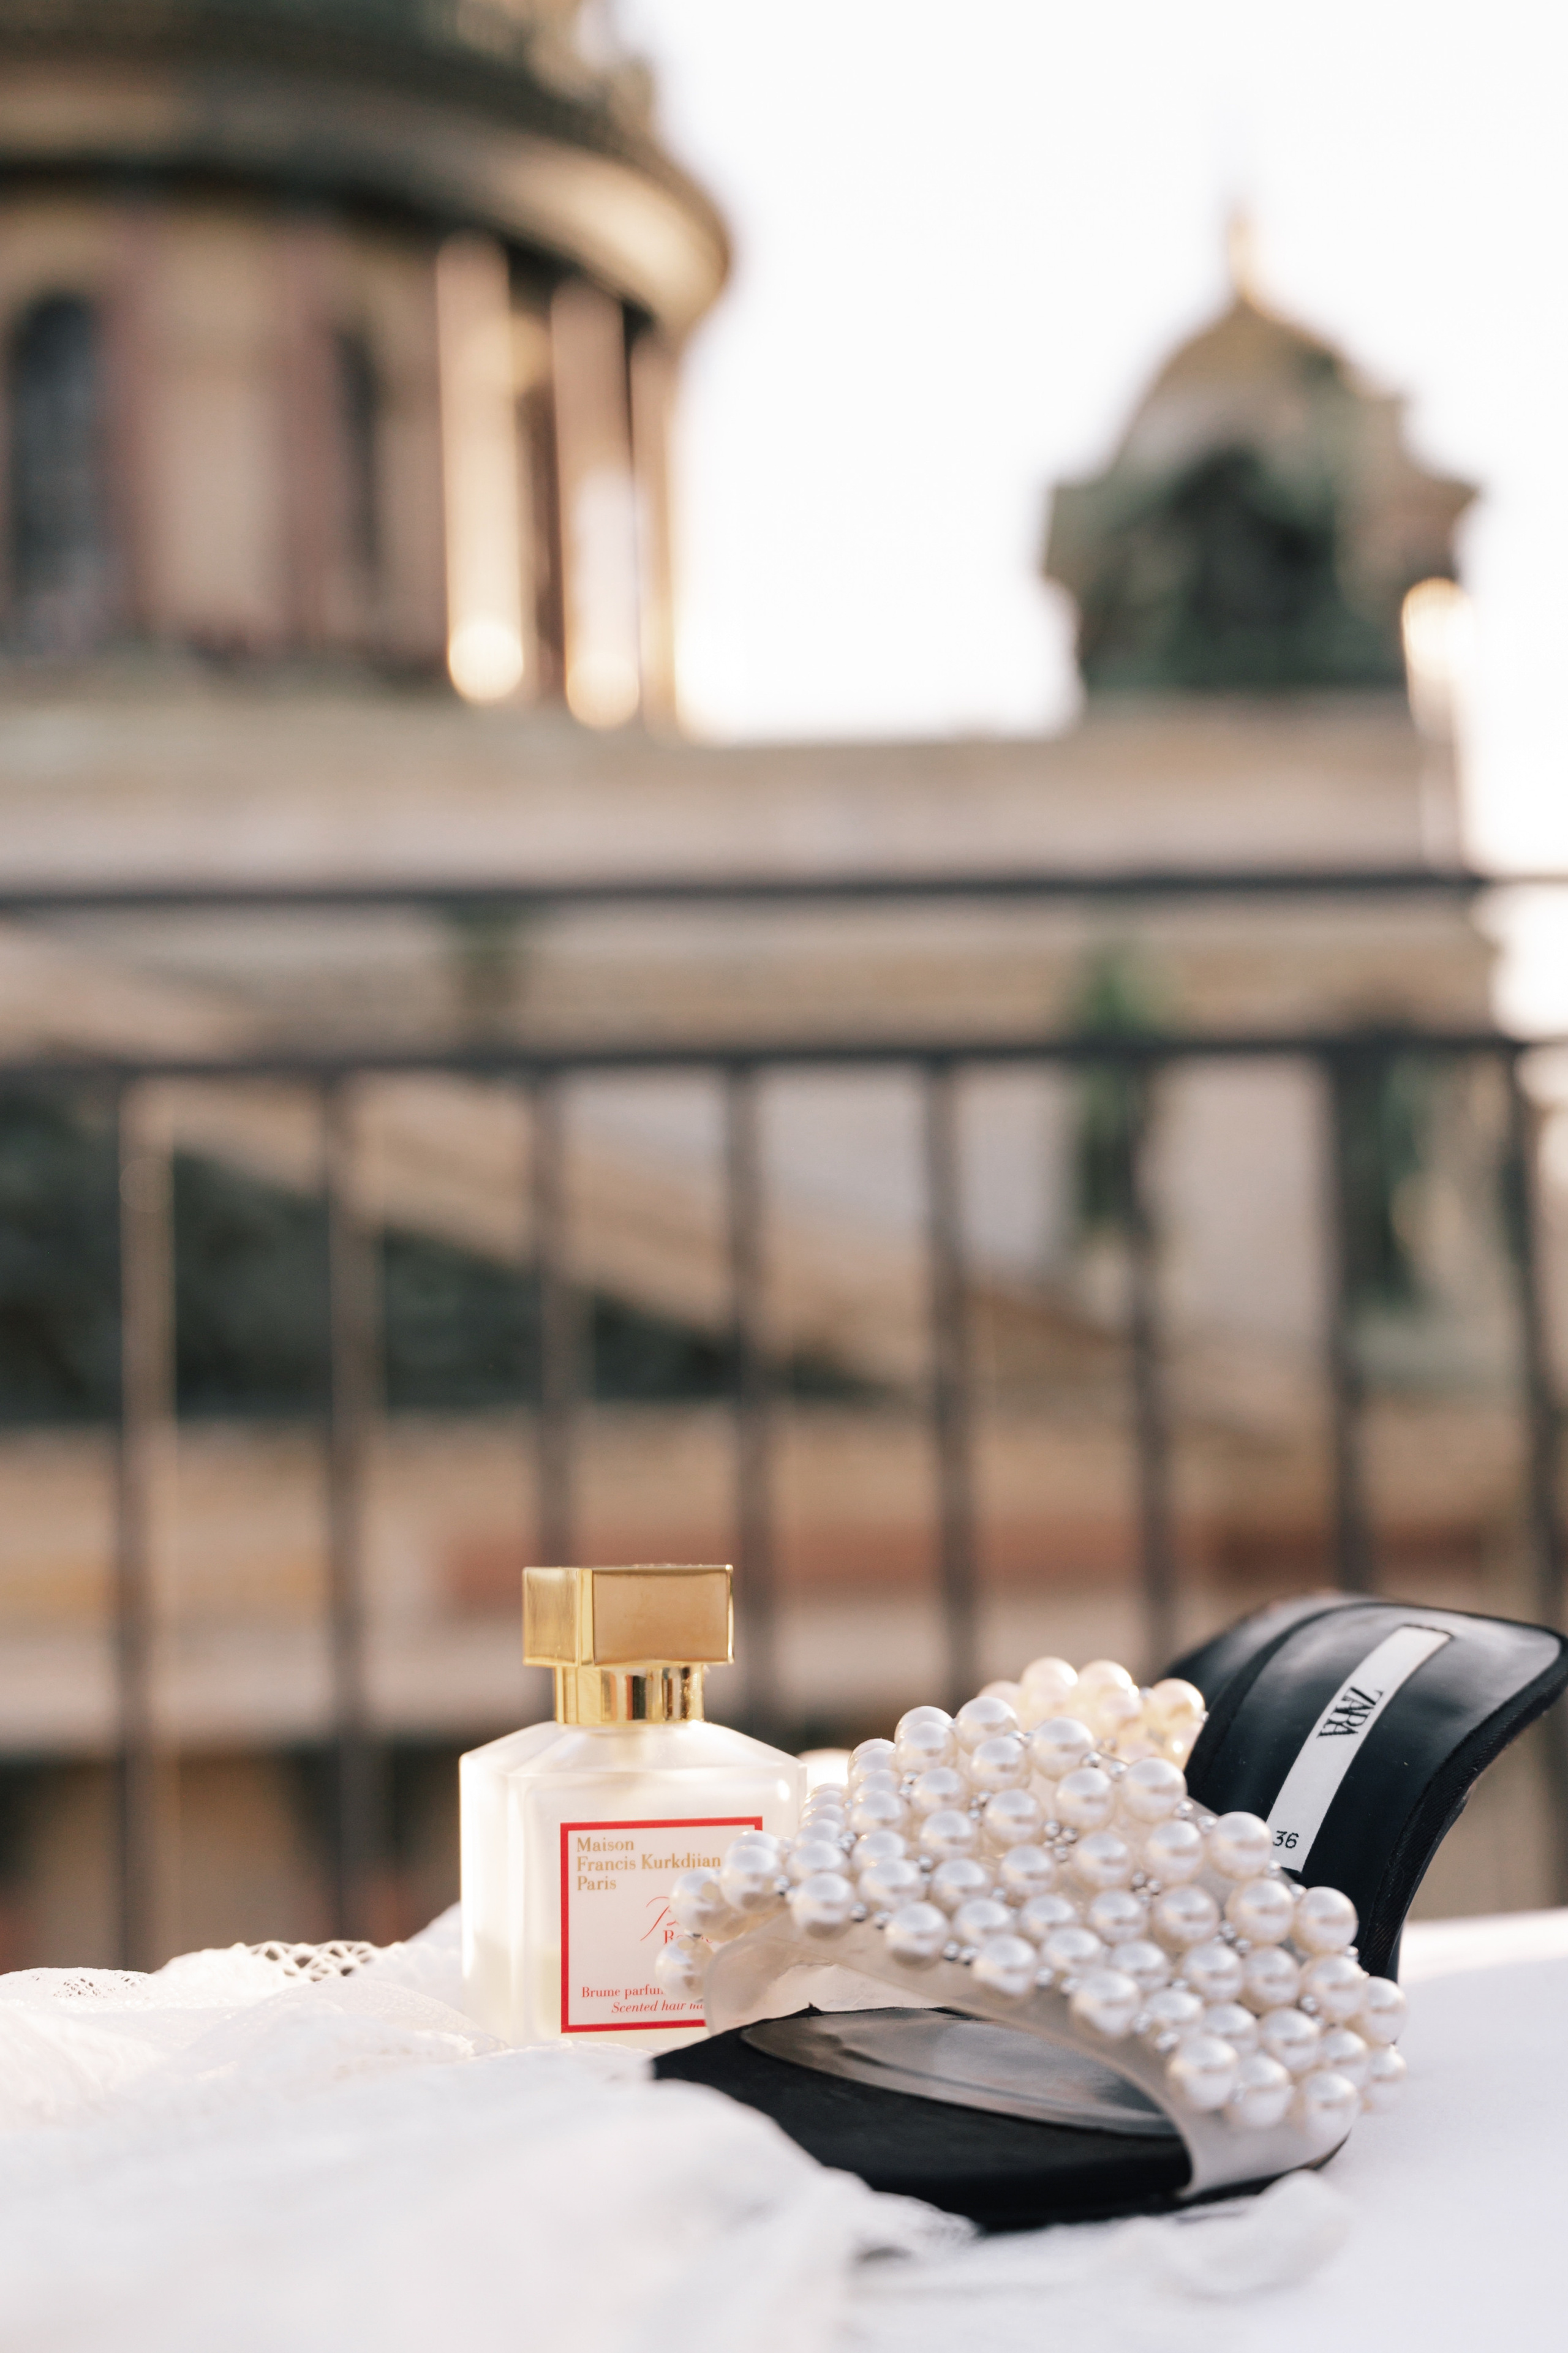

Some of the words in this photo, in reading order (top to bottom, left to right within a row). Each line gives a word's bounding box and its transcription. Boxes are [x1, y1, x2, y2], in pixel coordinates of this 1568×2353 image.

[1316, 1686, 1384, 1739] ZARA
[577, 1837, 635, 1852] Maison
[1273, 1830, 1300, 1849] 36
[577, 1856, 636, 1872] Francis
[641, 1853, 722, 1870] Kurkdjian
[577, 1875, 617, 1891] Paris
[582, 1986, 620, 1998] Brume
[611, 2000, 658, 2013] Scented
